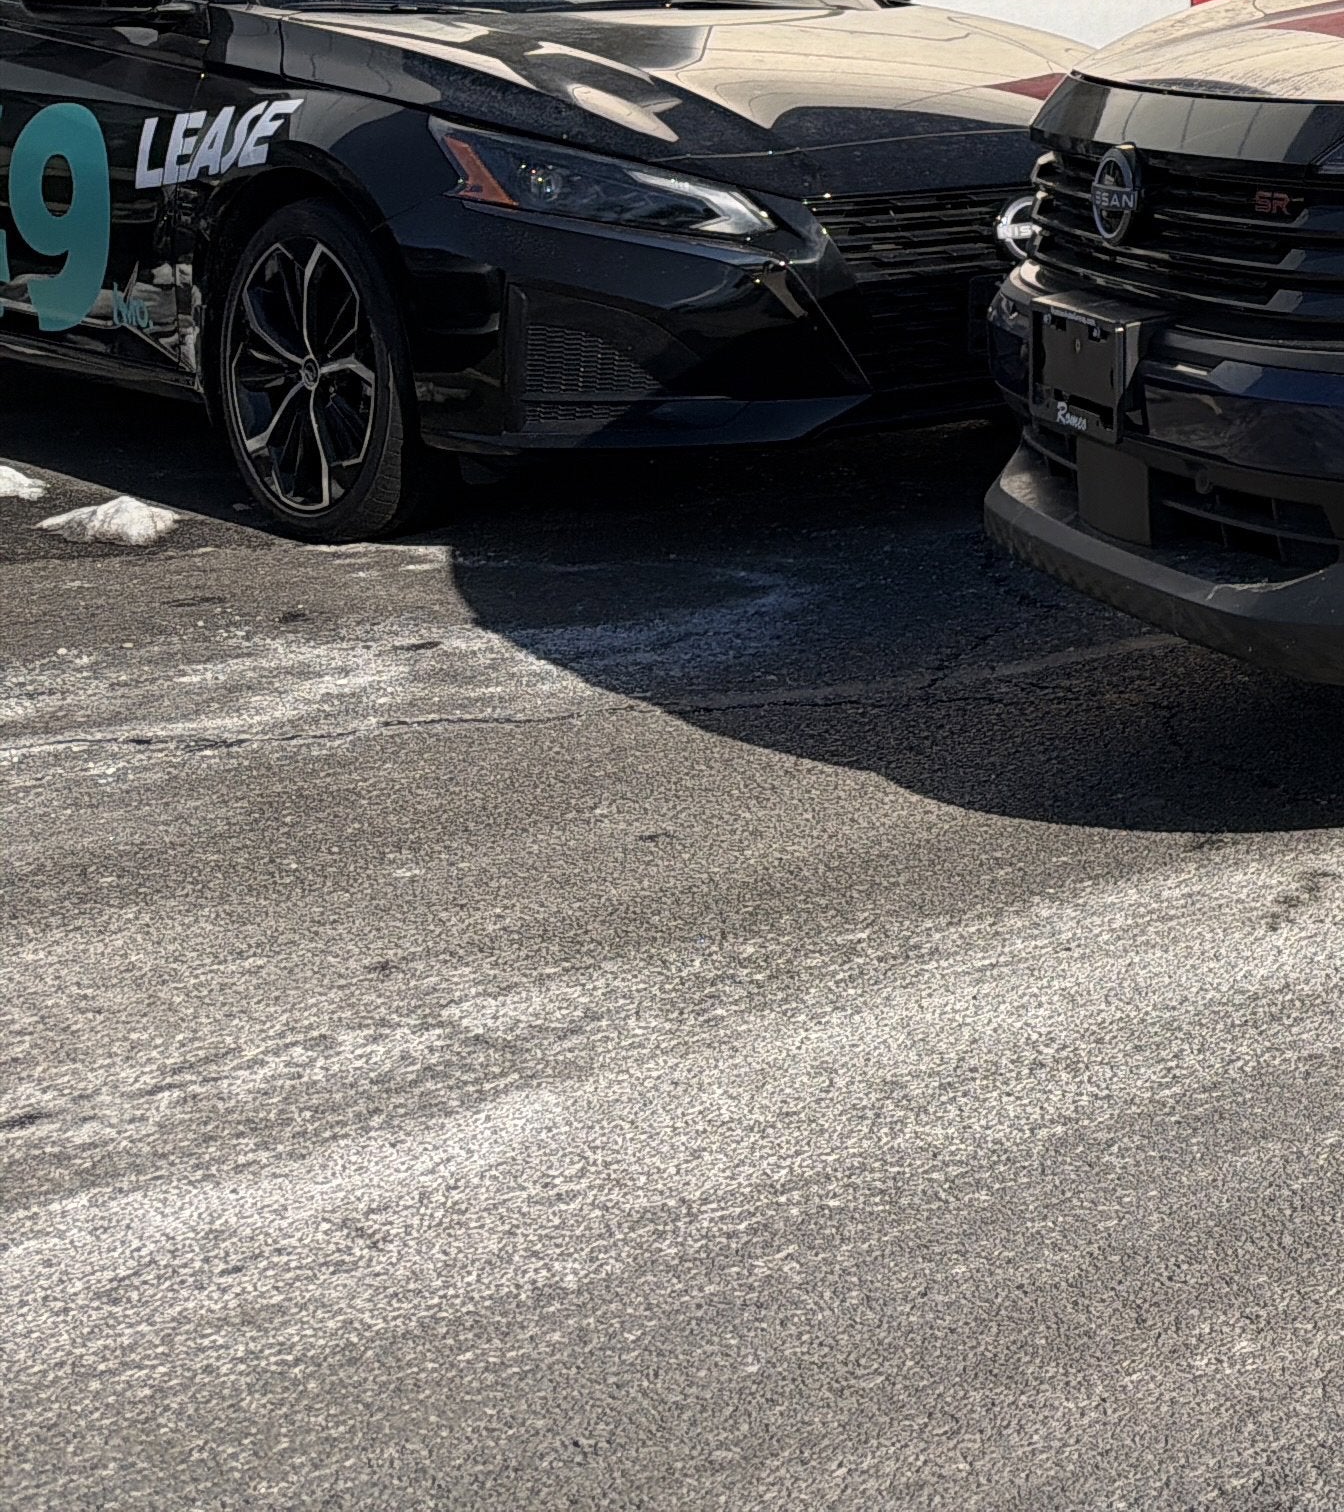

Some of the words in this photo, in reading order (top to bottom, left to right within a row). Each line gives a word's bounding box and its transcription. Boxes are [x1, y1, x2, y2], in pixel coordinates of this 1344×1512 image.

[1094, 185, 1134, 208] SSAN
[1254, 190, 1291, 215] SR
[0, 102, 111, 332] 9
[135, 99, 304, 189] LEASE
[1003, 224, 1032, 238] NIS
